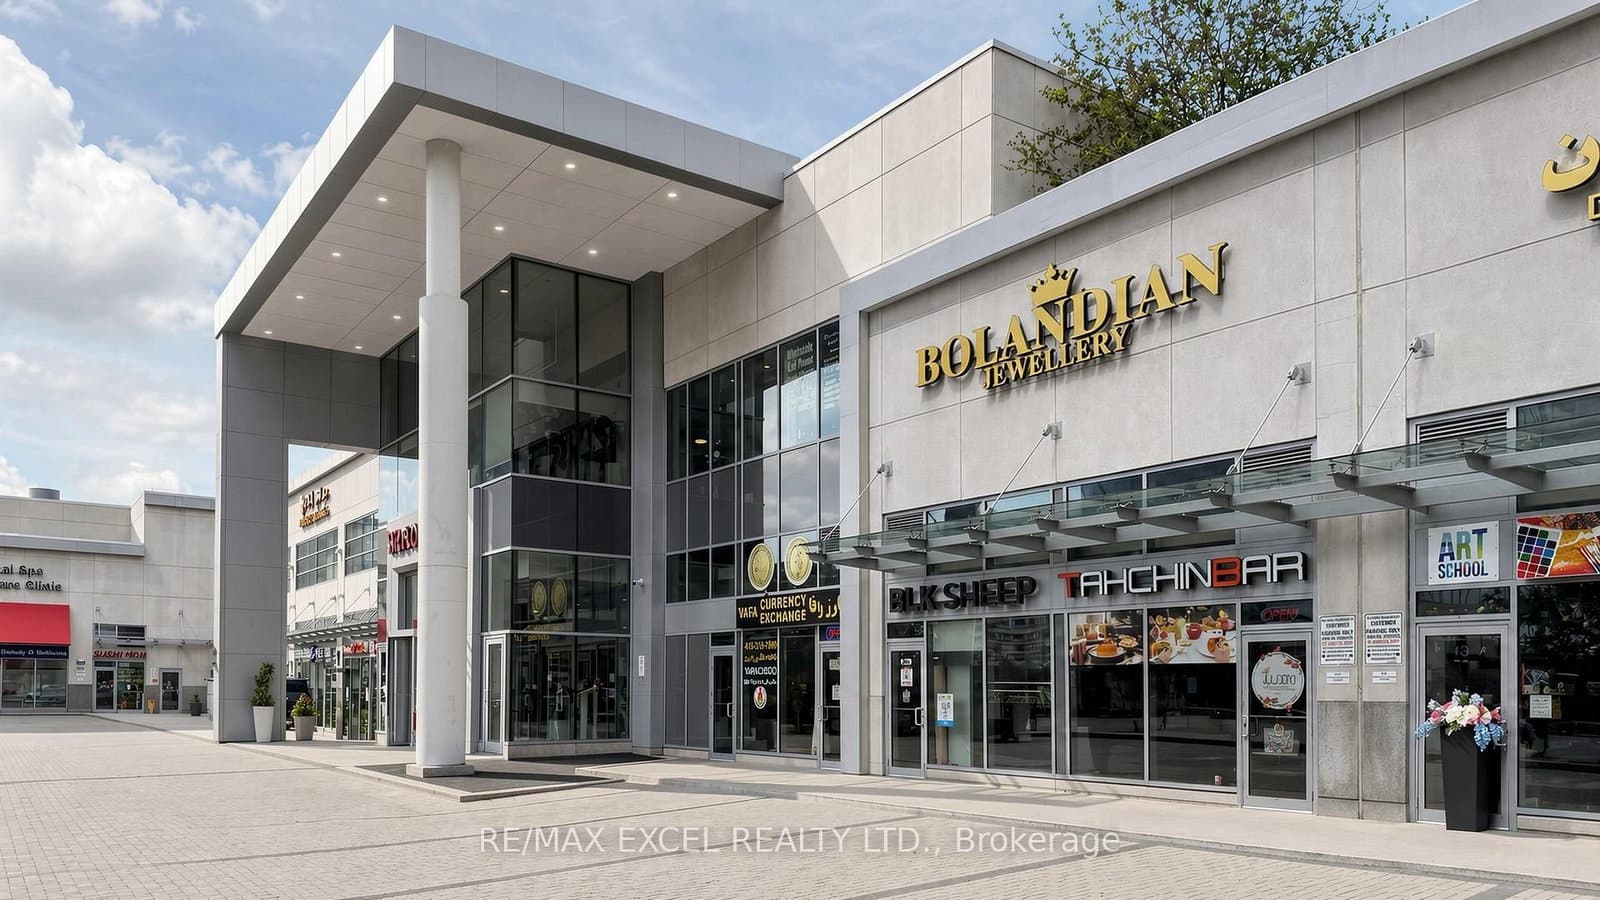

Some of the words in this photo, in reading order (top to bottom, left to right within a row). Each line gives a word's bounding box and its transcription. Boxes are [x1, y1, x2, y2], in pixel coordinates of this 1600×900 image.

[915, 240, 1229, 388] BOLANDIAN
[982, 321, 1133, 390] JEWELLERY
[1438, 528, 1488, 562] ART
[1438, 560, 1488, 579] SCHOOL
[760, 594, 807, 610] CURRENCY
[889, 585, 938, 613] BLK
[942, 576, 1037, 609] SHEEP
[738, 606, 758, 619] VAFA
[760, 609, 807, 624] EXCHANGE
